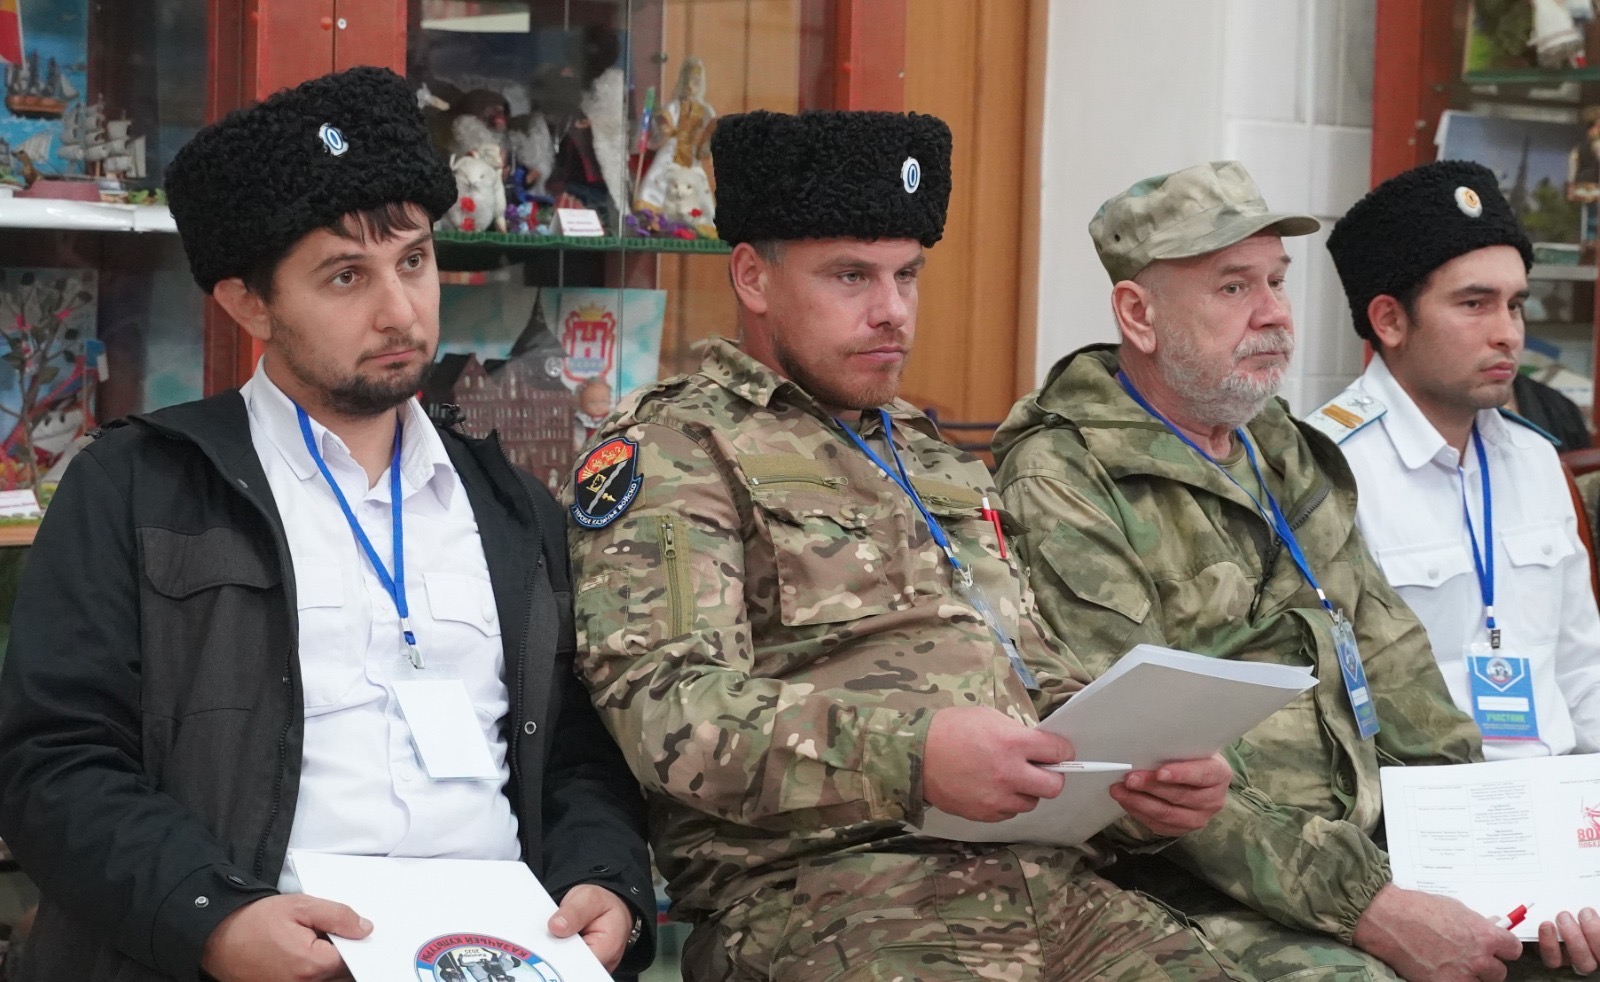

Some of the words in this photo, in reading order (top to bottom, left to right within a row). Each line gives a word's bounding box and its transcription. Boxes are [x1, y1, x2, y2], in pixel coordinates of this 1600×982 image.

[617, 483, 637, 511] ВОЙСКО
[1577, 828, 1594, 841] 80
[421, 936, 462, 963] КУЛЬТУРЫ
[465, 936, 527, 958] КАЗАЧЬЕЙ
